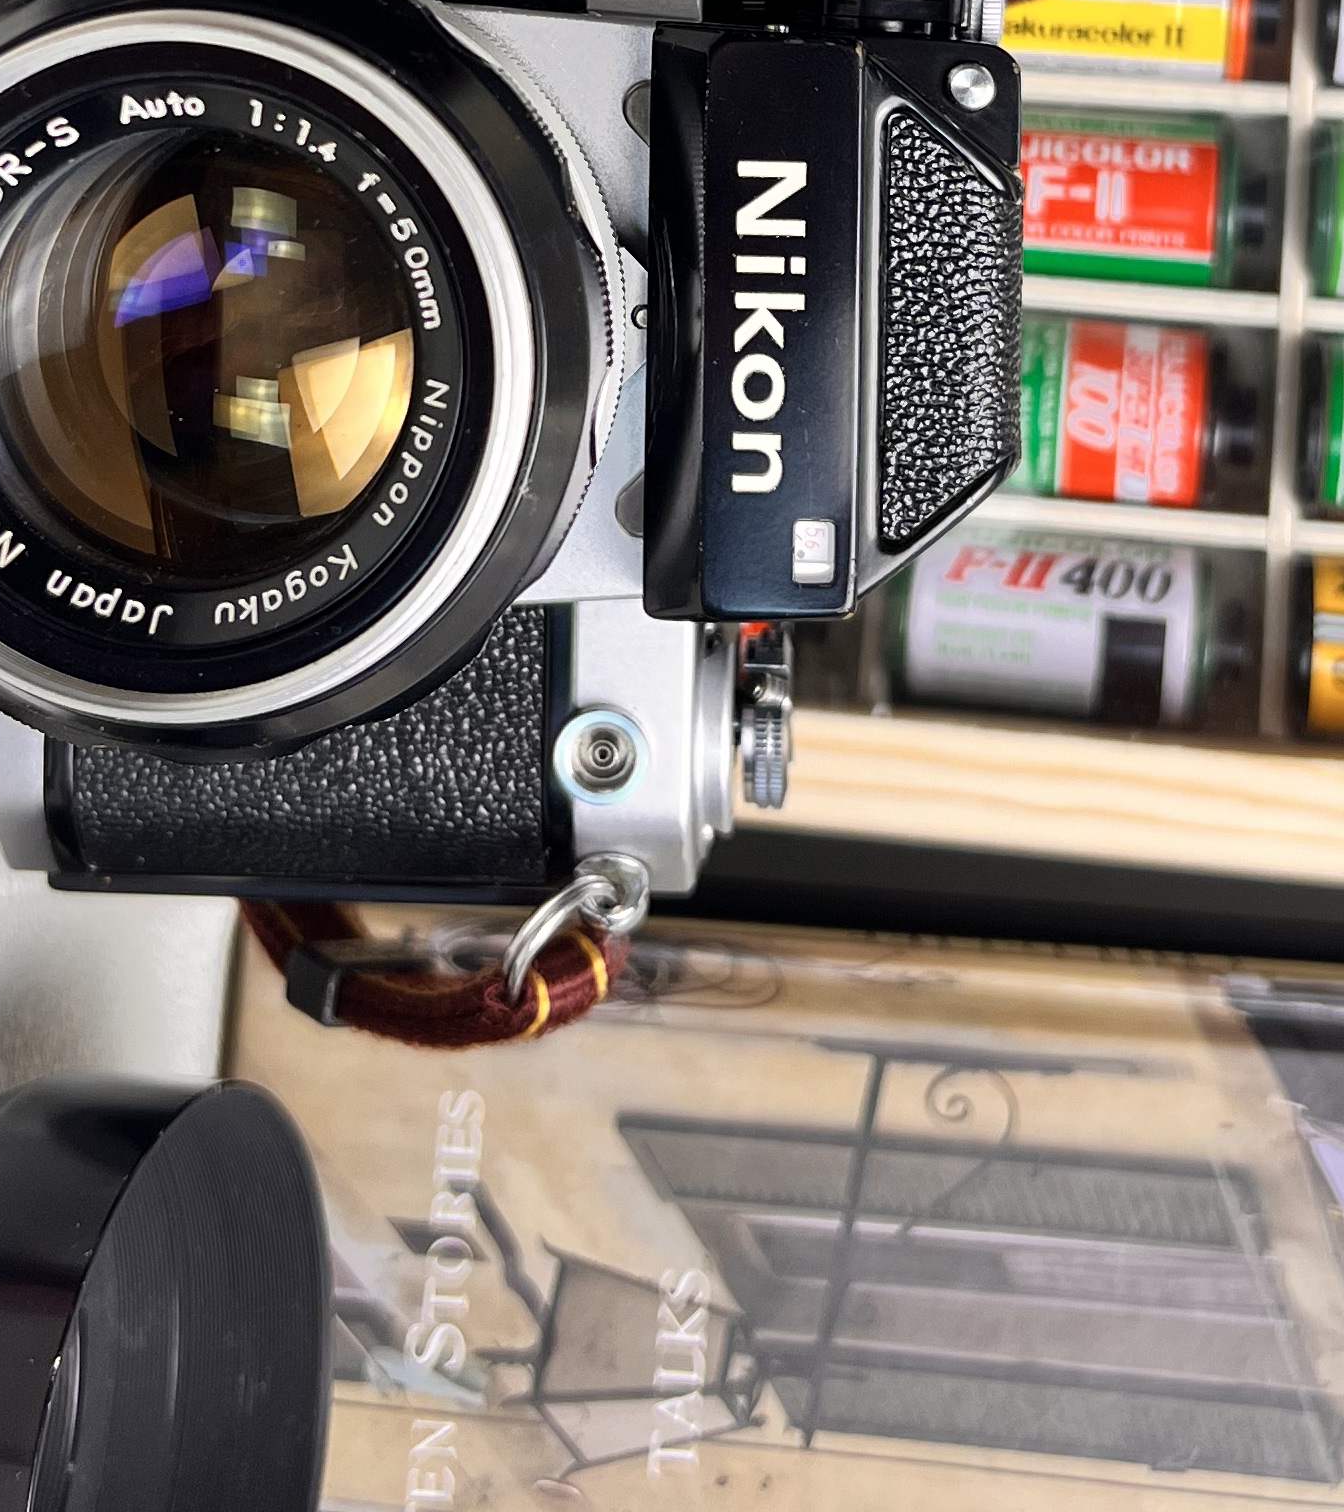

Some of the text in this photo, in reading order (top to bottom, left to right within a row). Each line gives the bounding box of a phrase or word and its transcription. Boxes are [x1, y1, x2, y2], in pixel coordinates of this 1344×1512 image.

[1004, 17, 1155, 46] akuracolor
[118, 92, 206, 126] Auto
[247, 99, 340, 164] 1:1.4
[730, 159, 808, 494] Nikon
[370, 378, 451, 529] Nippon
[43, 568, 174, 635] Japan
[212, 543, 359, 628] Kogaku
[401, 1087, 488, 1371] STORIES
[645, 1265, 713, 1481] TALKS
